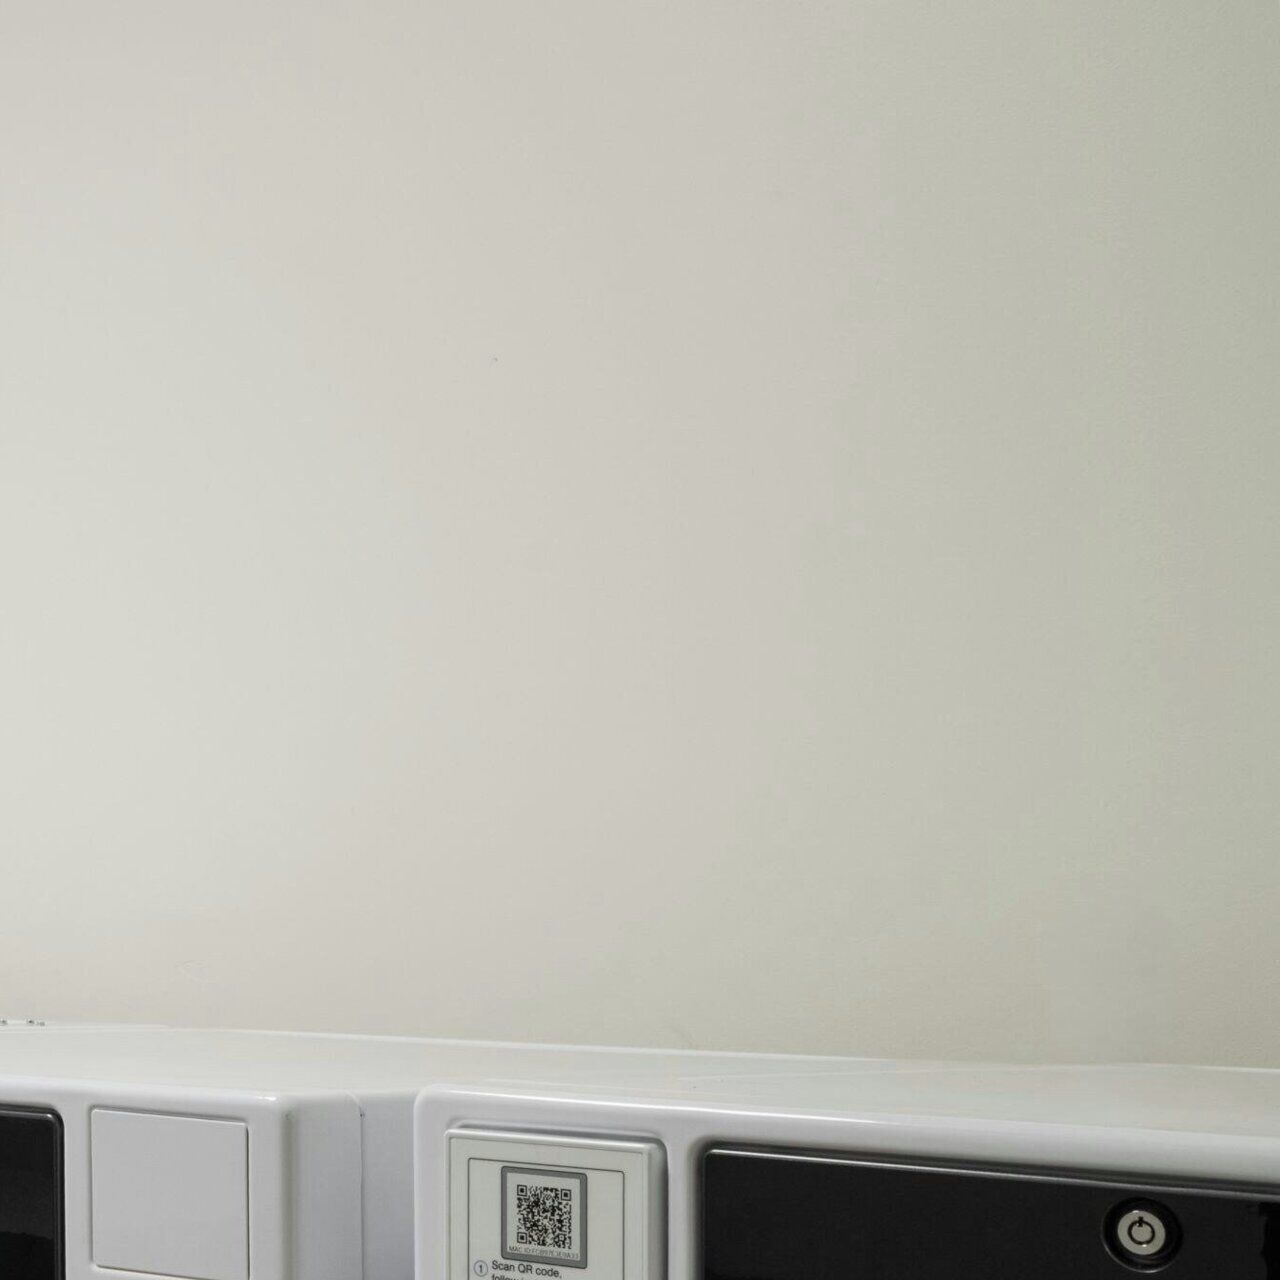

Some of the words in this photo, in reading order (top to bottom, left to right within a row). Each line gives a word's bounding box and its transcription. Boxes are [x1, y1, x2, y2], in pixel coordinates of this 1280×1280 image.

[492, 1260, 515, 1272] Scan
[518, 1263, 533, 1275] QR
[535, 1267, 562, 1280] code,
